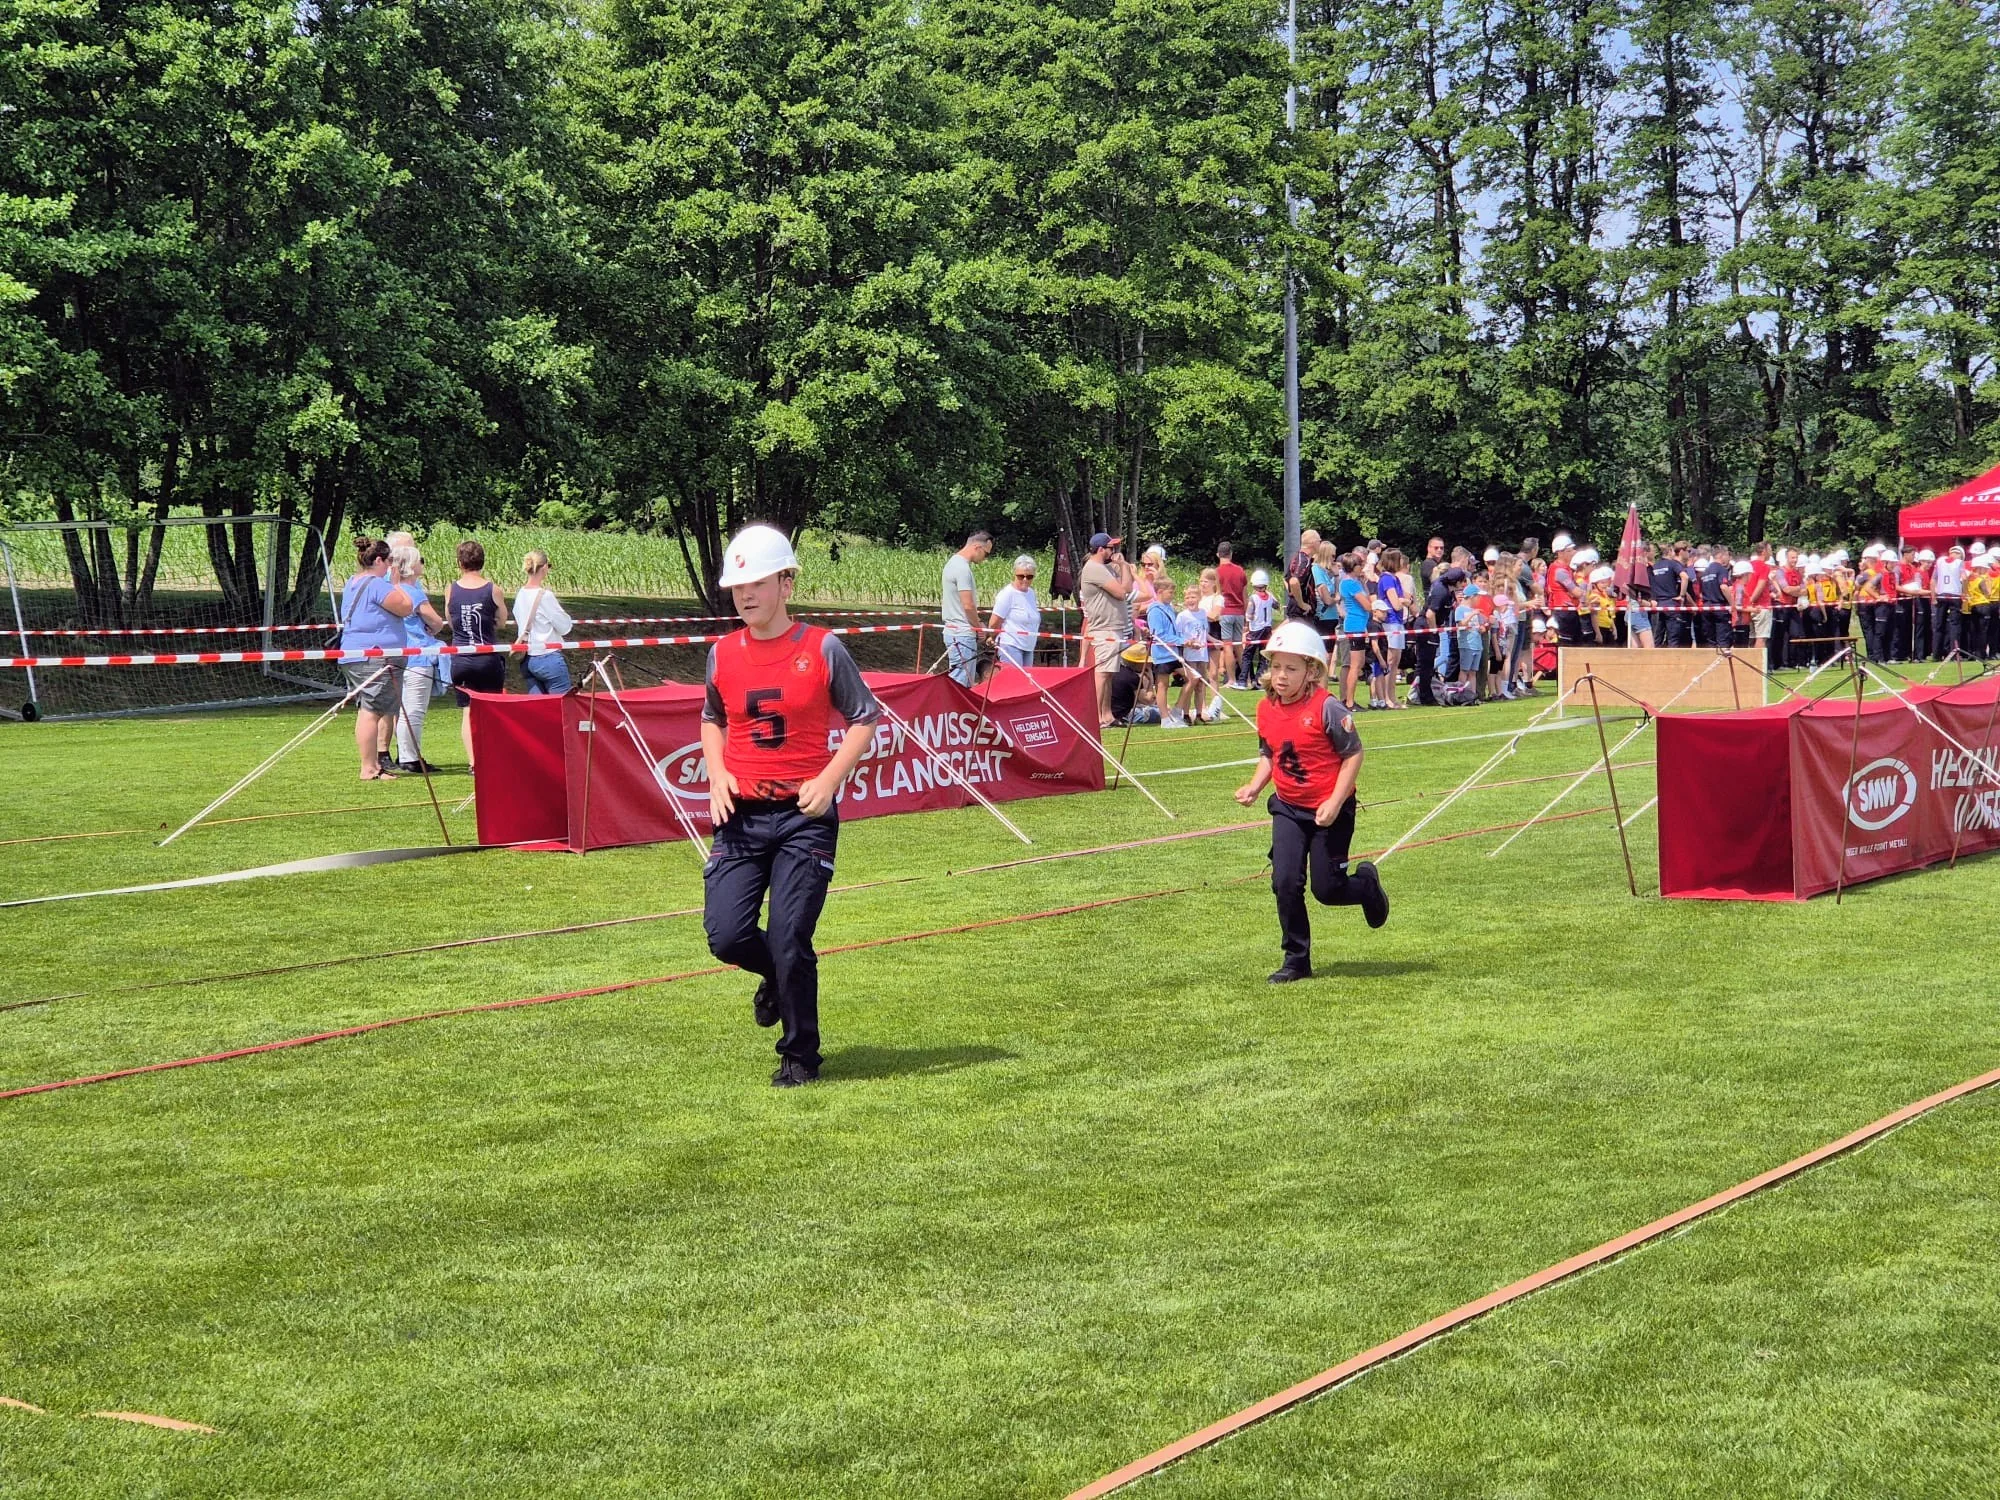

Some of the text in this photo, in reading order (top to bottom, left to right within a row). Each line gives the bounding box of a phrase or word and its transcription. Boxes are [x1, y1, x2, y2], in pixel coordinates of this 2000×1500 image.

[1824, 585, 1831, 598] 7
[744, 687, 787, 751] 5
[1015, 719, 1050, 733] HELDEN IM
[1278, 739, 1310, 784] 4
[1858, 774, 1899, 813] SMW
